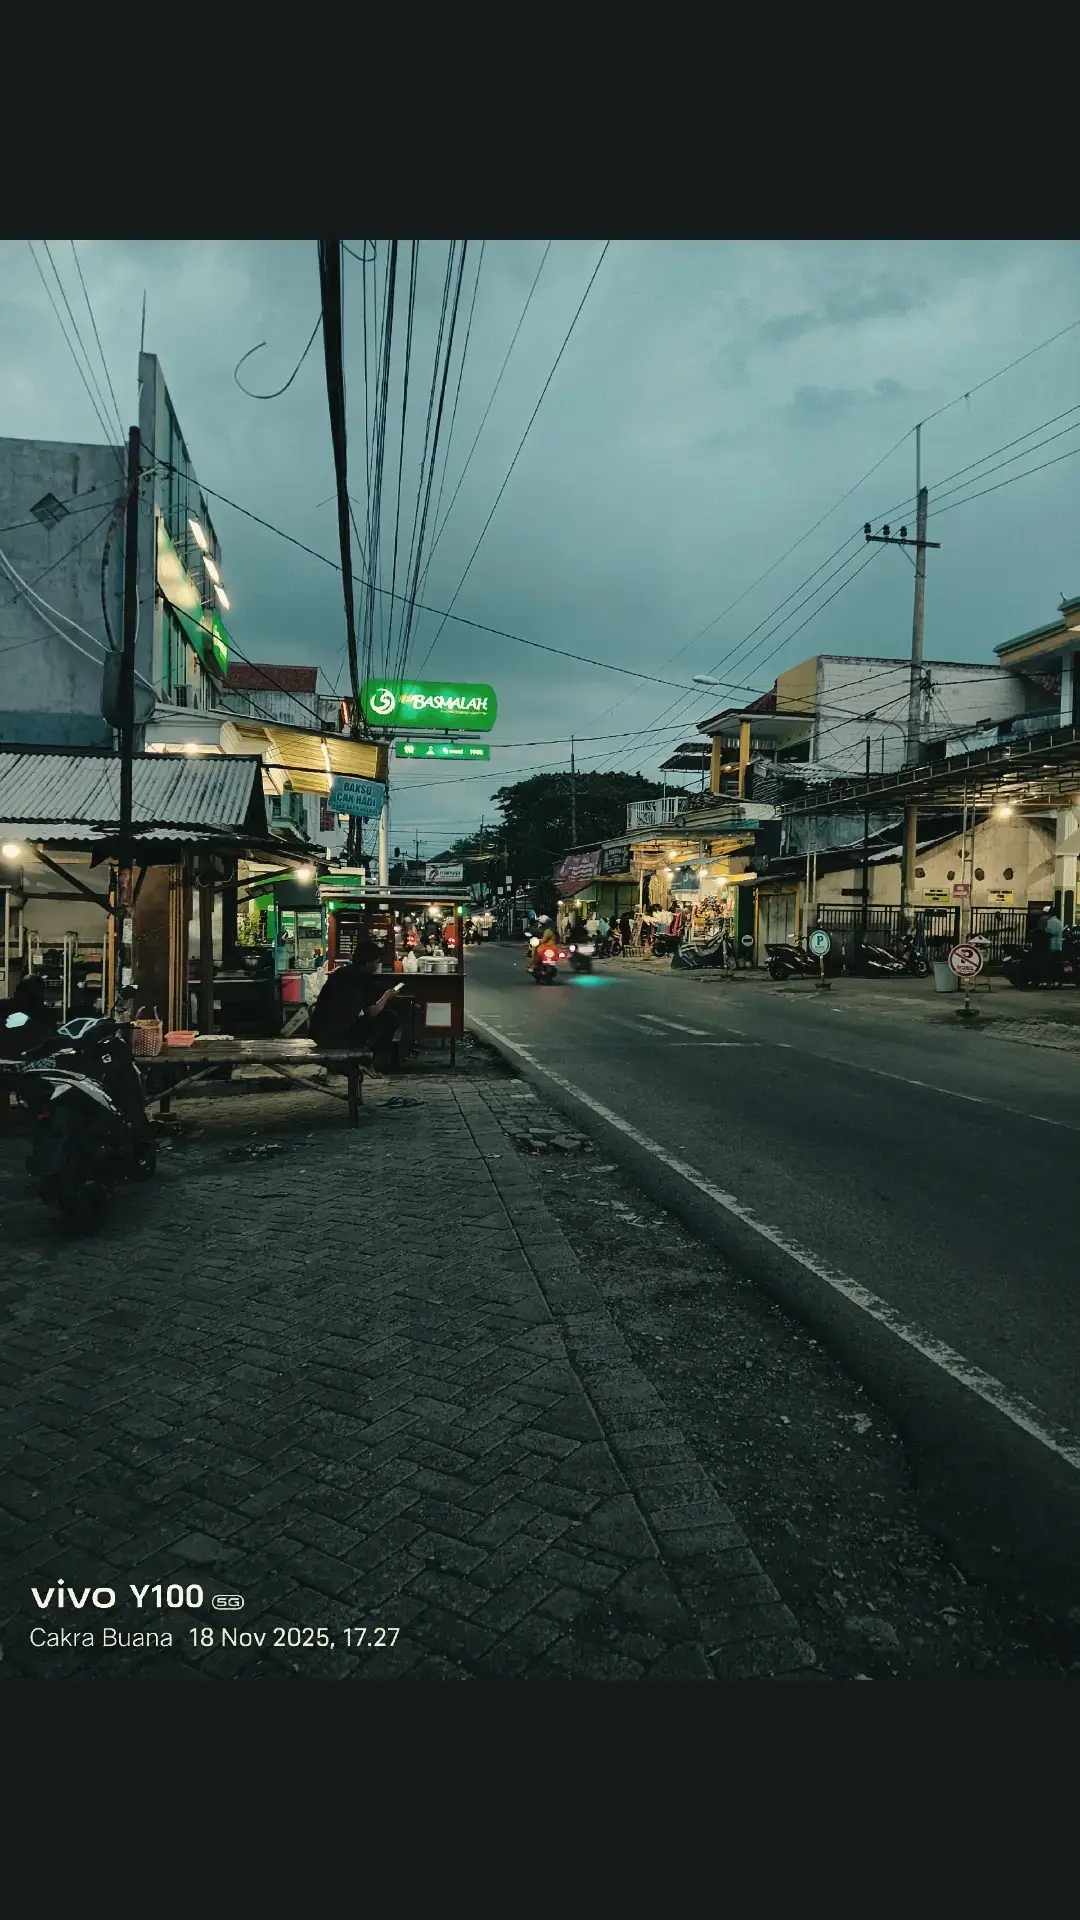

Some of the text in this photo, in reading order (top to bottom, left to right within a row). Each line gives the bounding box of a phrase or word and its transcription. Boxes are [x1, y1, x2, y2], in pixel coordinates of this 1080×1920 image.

[412, 695, 488, 710] BASMALAH
[343, 781, 372, 795] BAKSO
[336, 791, 377, 807] CAK HADI
[816, 935, 824, 946] P
[961, 949, 973, 963] P
